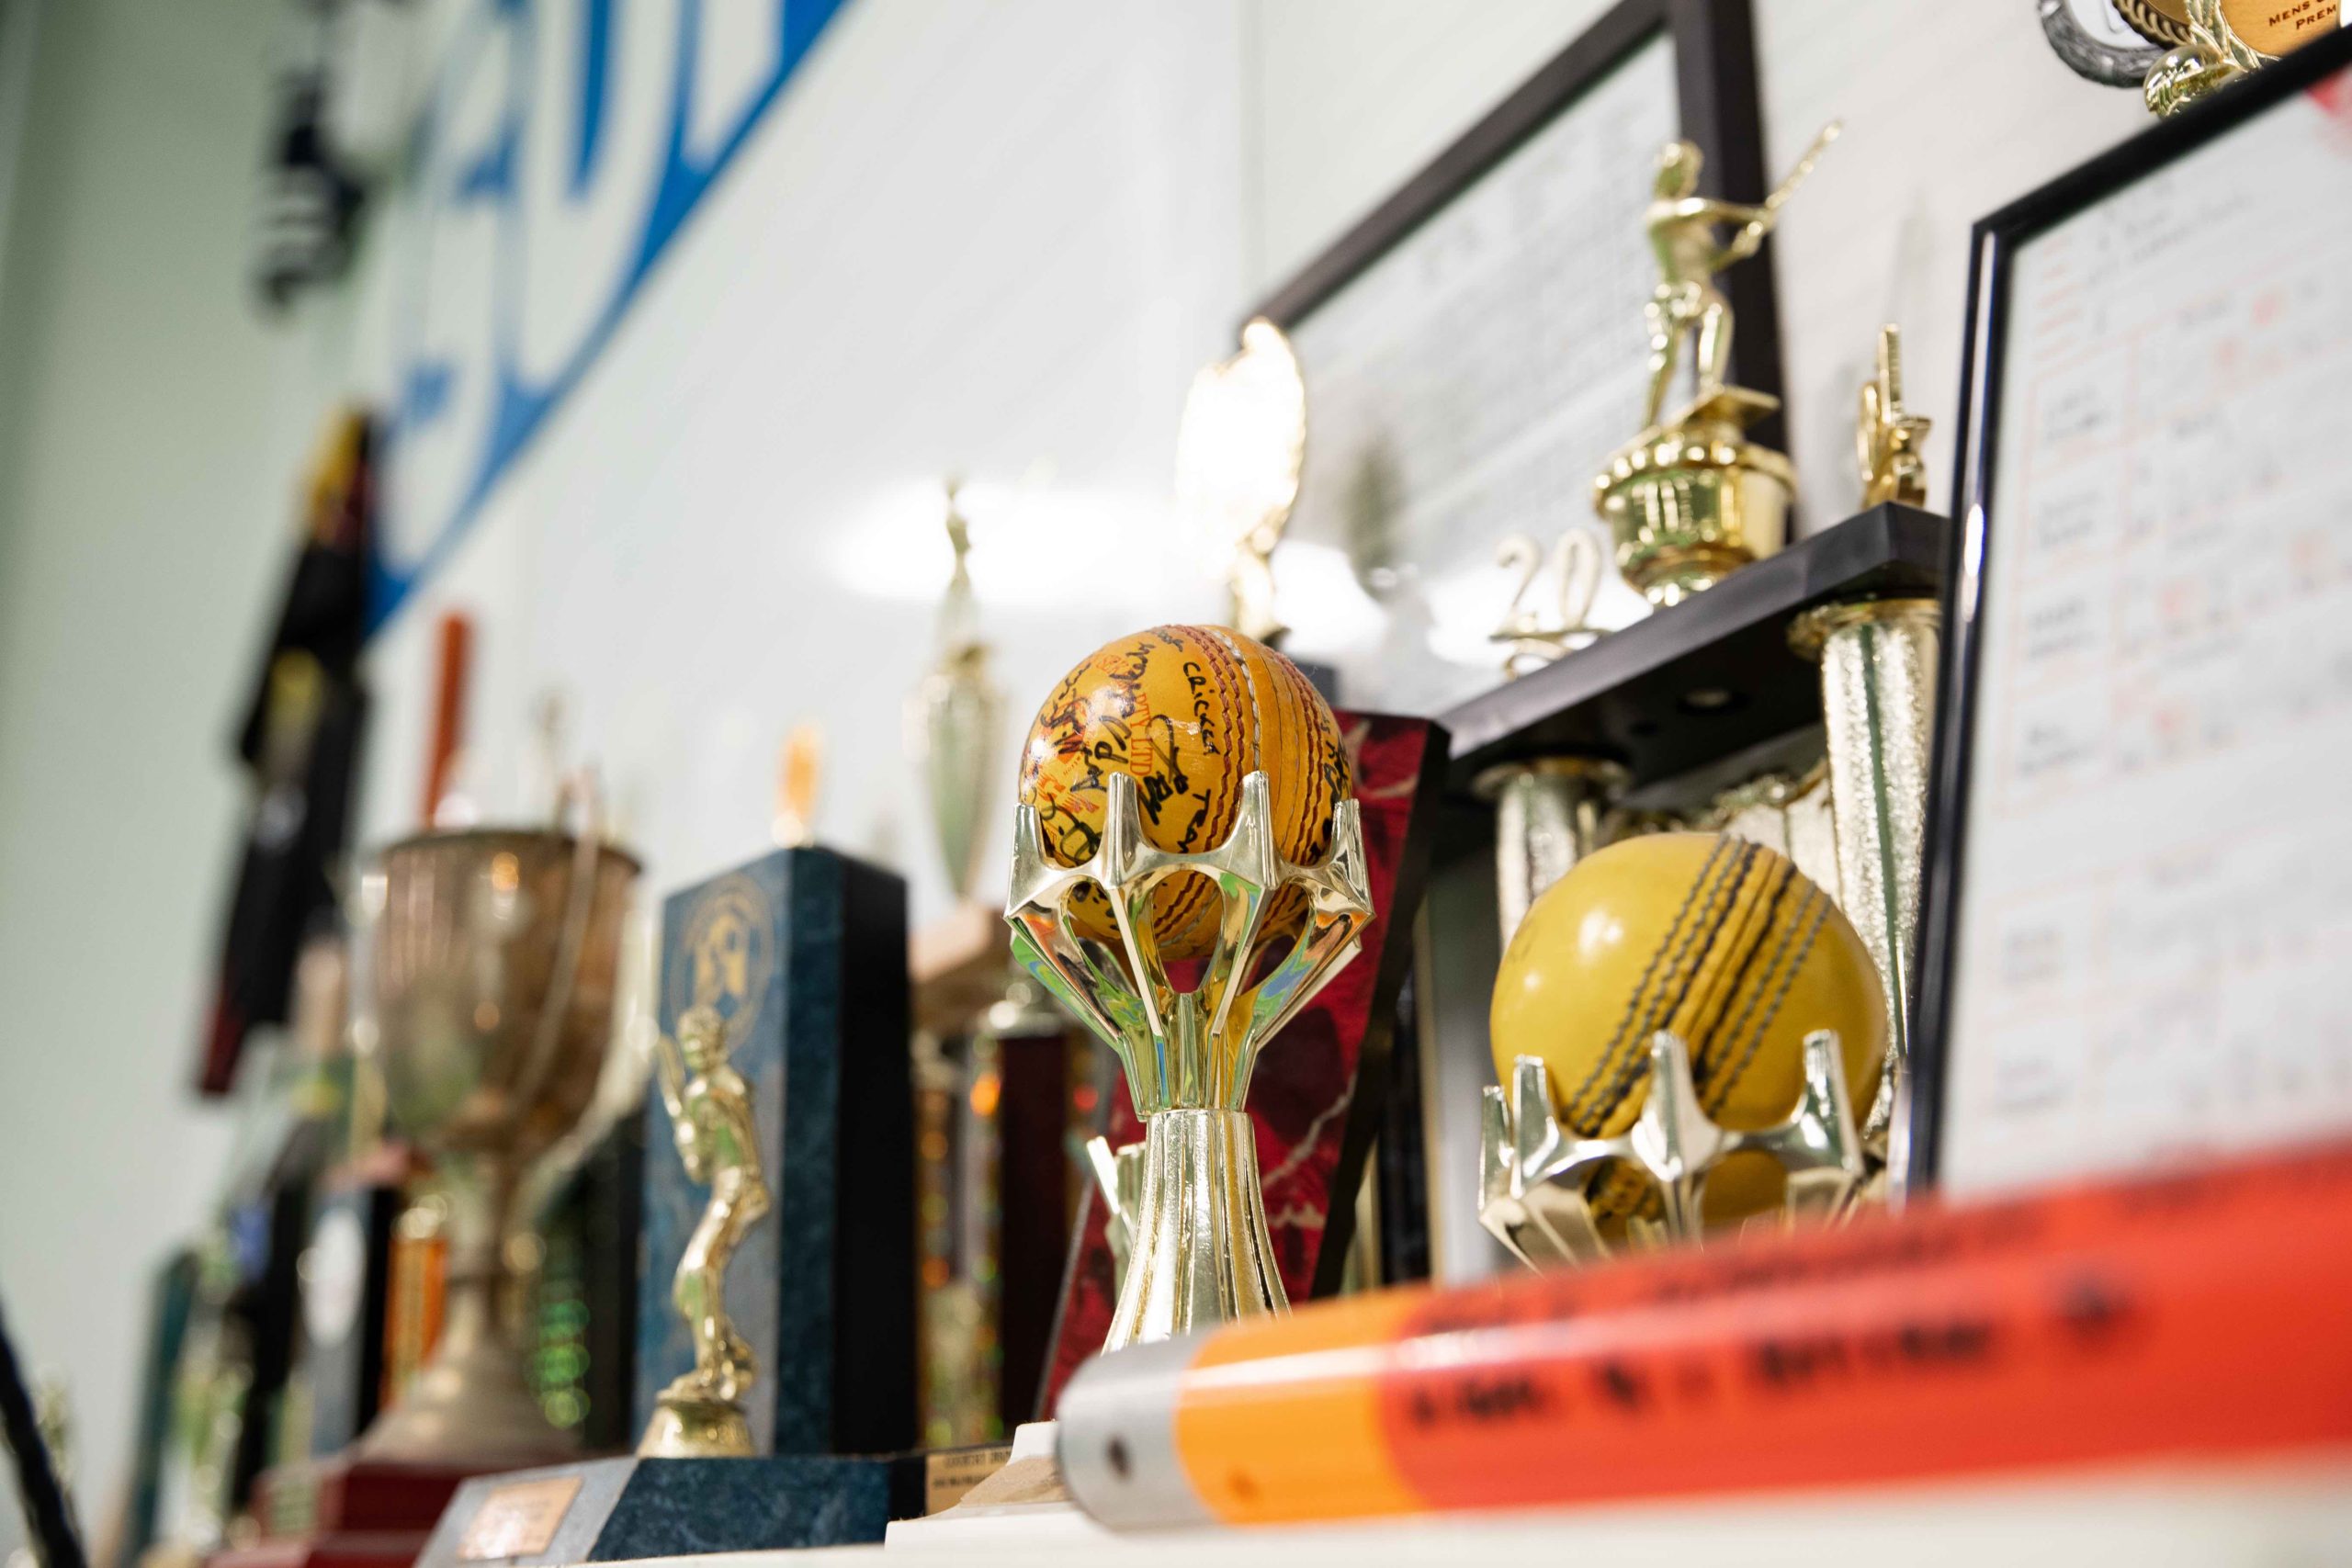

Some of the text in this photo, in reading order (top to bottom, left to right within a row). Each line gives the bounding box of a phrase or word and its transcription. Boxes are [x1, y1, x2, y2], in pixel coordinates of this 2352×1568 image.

[2268, 1, 2310, 27] MENS
[2296, 5, 2336, 29] PREM
[1130, 737, 1154, 776] LTD
